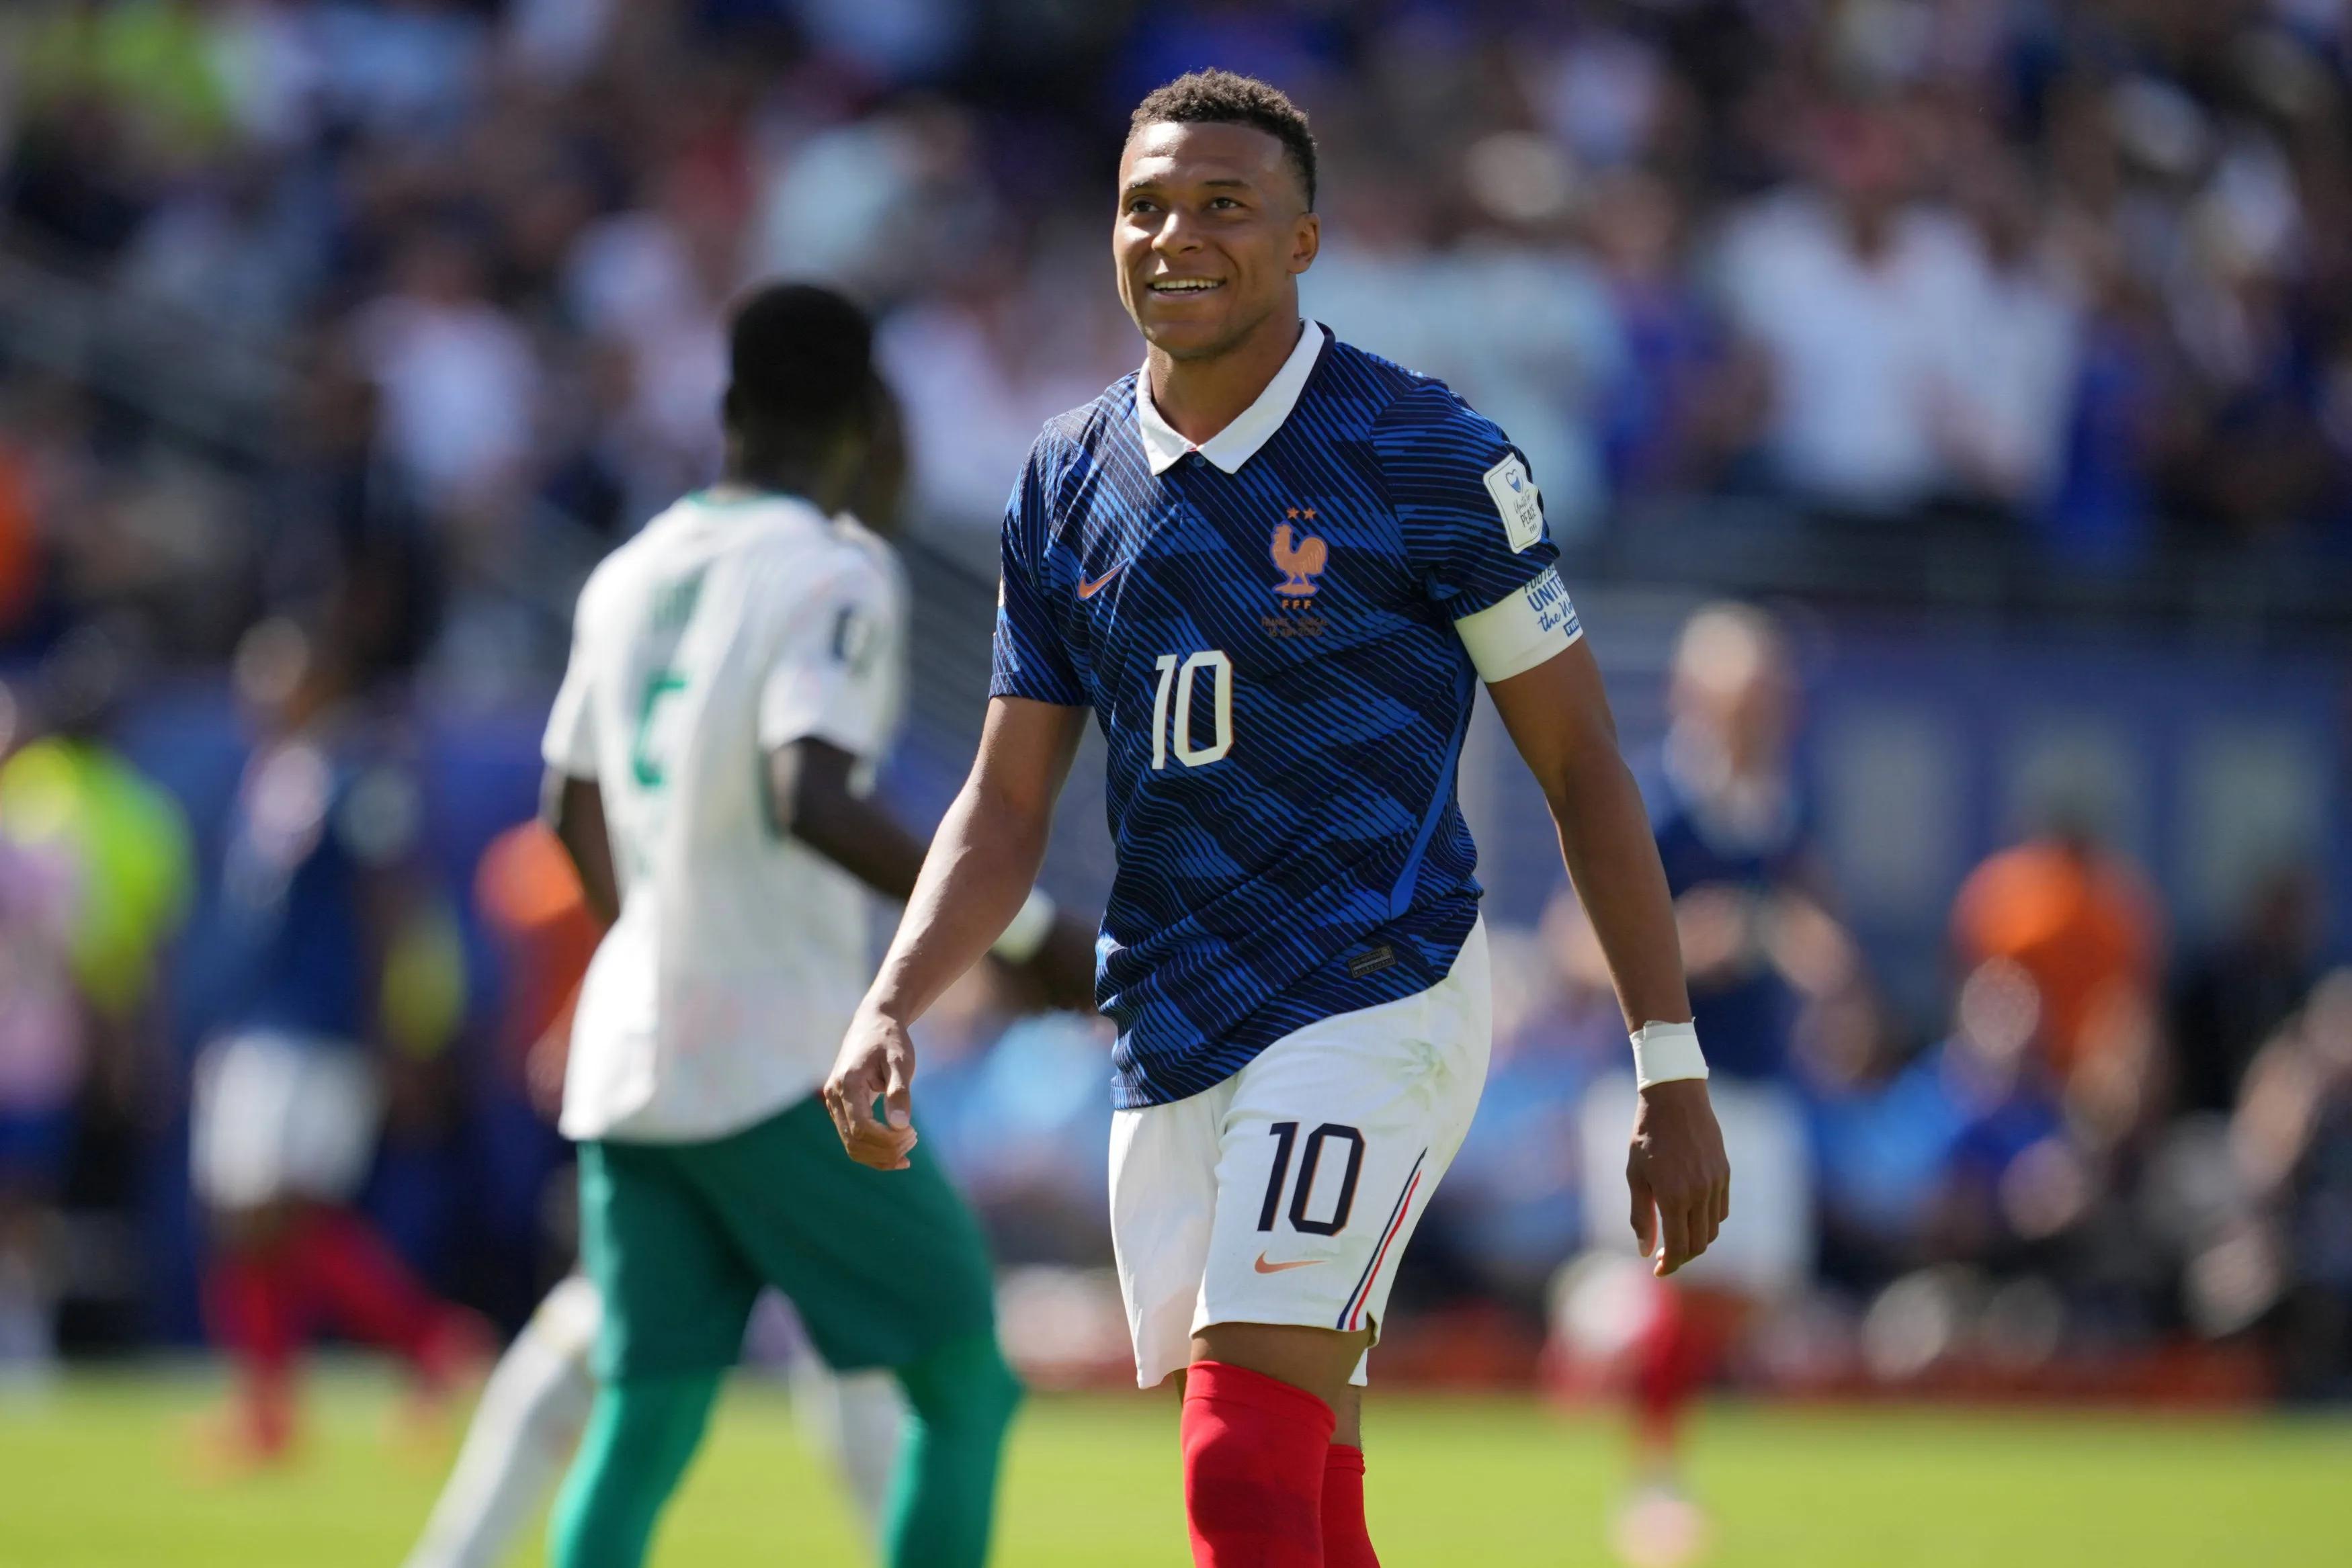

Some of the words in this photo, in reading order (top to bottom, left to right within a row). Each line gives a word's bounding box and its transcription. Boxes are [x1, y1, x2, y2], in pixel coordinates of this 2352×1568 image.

[1282, 599, 1312, 610] FFF
[1537, 611, 1561, 632] the
[1152, 650, 1234, 770] 10
[1257, 1121, 1366, 1237] 10
